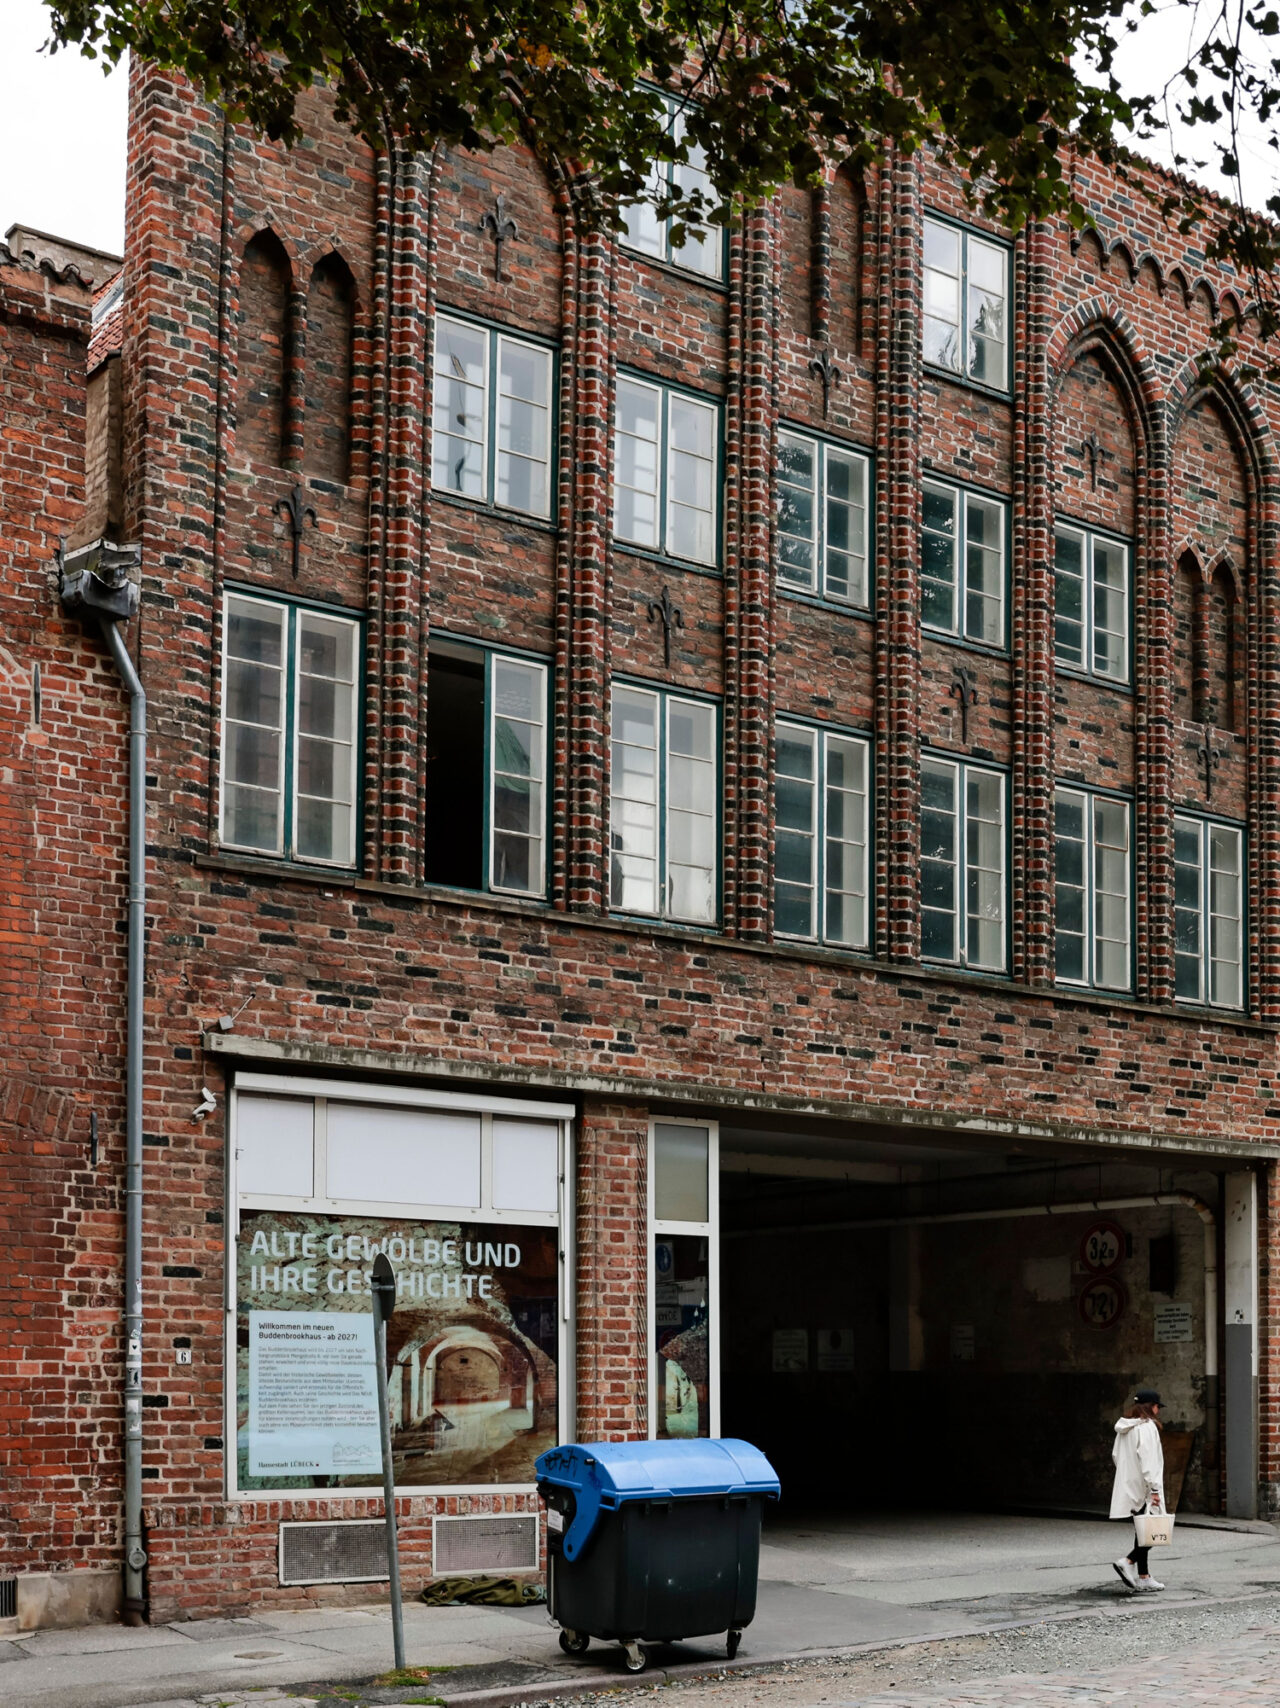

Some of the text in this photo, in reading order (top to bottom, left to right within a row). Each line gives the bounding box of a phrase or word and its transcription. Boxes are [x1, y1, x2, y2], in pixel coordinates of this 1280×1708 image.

[250, 1230, 521, 1268] ALTE GEWÖLBE UND
[250, 1266, 493, 1299] IHRE GESHICHTE
[258, 1332, 321, 1340] Buddenbrookhaus
[181, 1351, 186, 1363] 6
